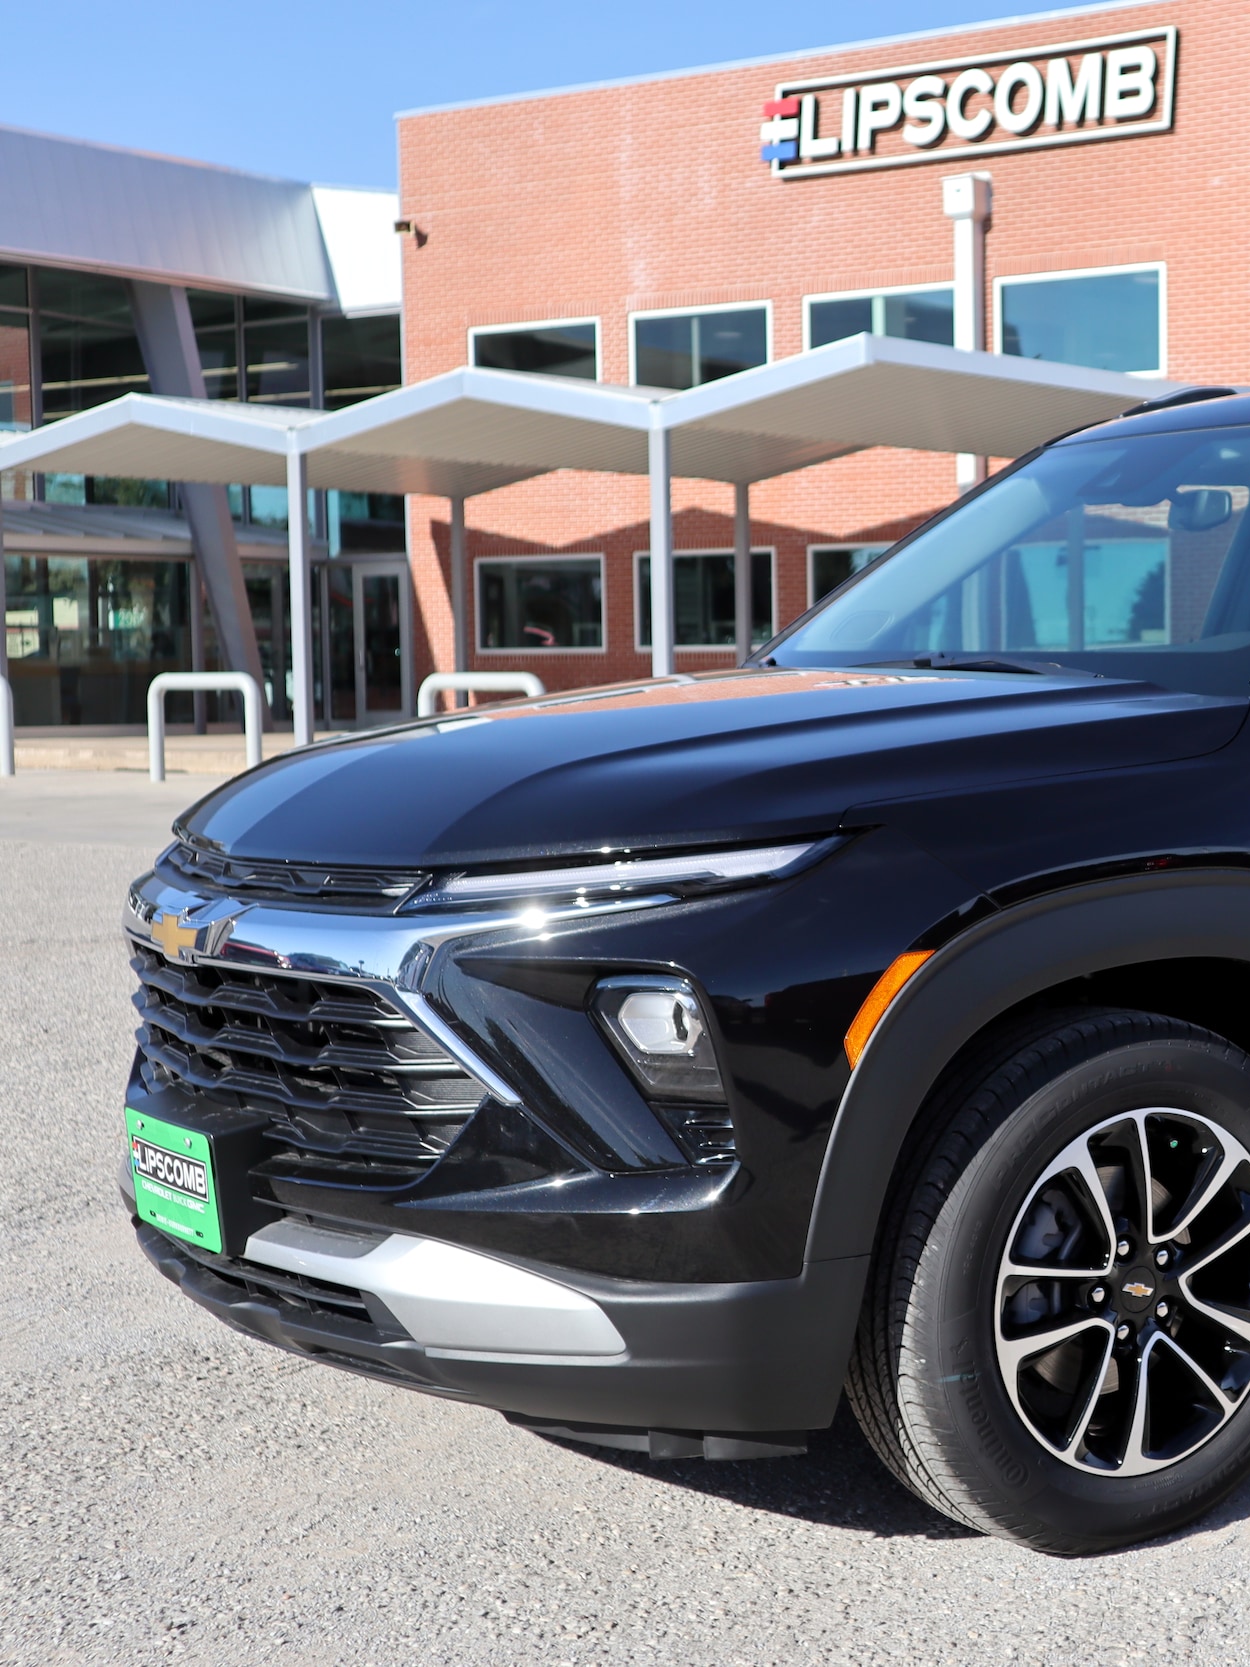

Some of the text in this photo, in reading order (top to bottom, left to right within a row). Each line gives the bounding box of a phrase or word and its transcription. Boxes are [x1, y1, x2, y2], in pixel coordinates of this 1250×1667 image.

[799, 45, 1157, 158] LIPSCOMB
[137, 1143, 207, 1195] LIPSCOMB
[951, 1360, 1031, 1488] Continental
